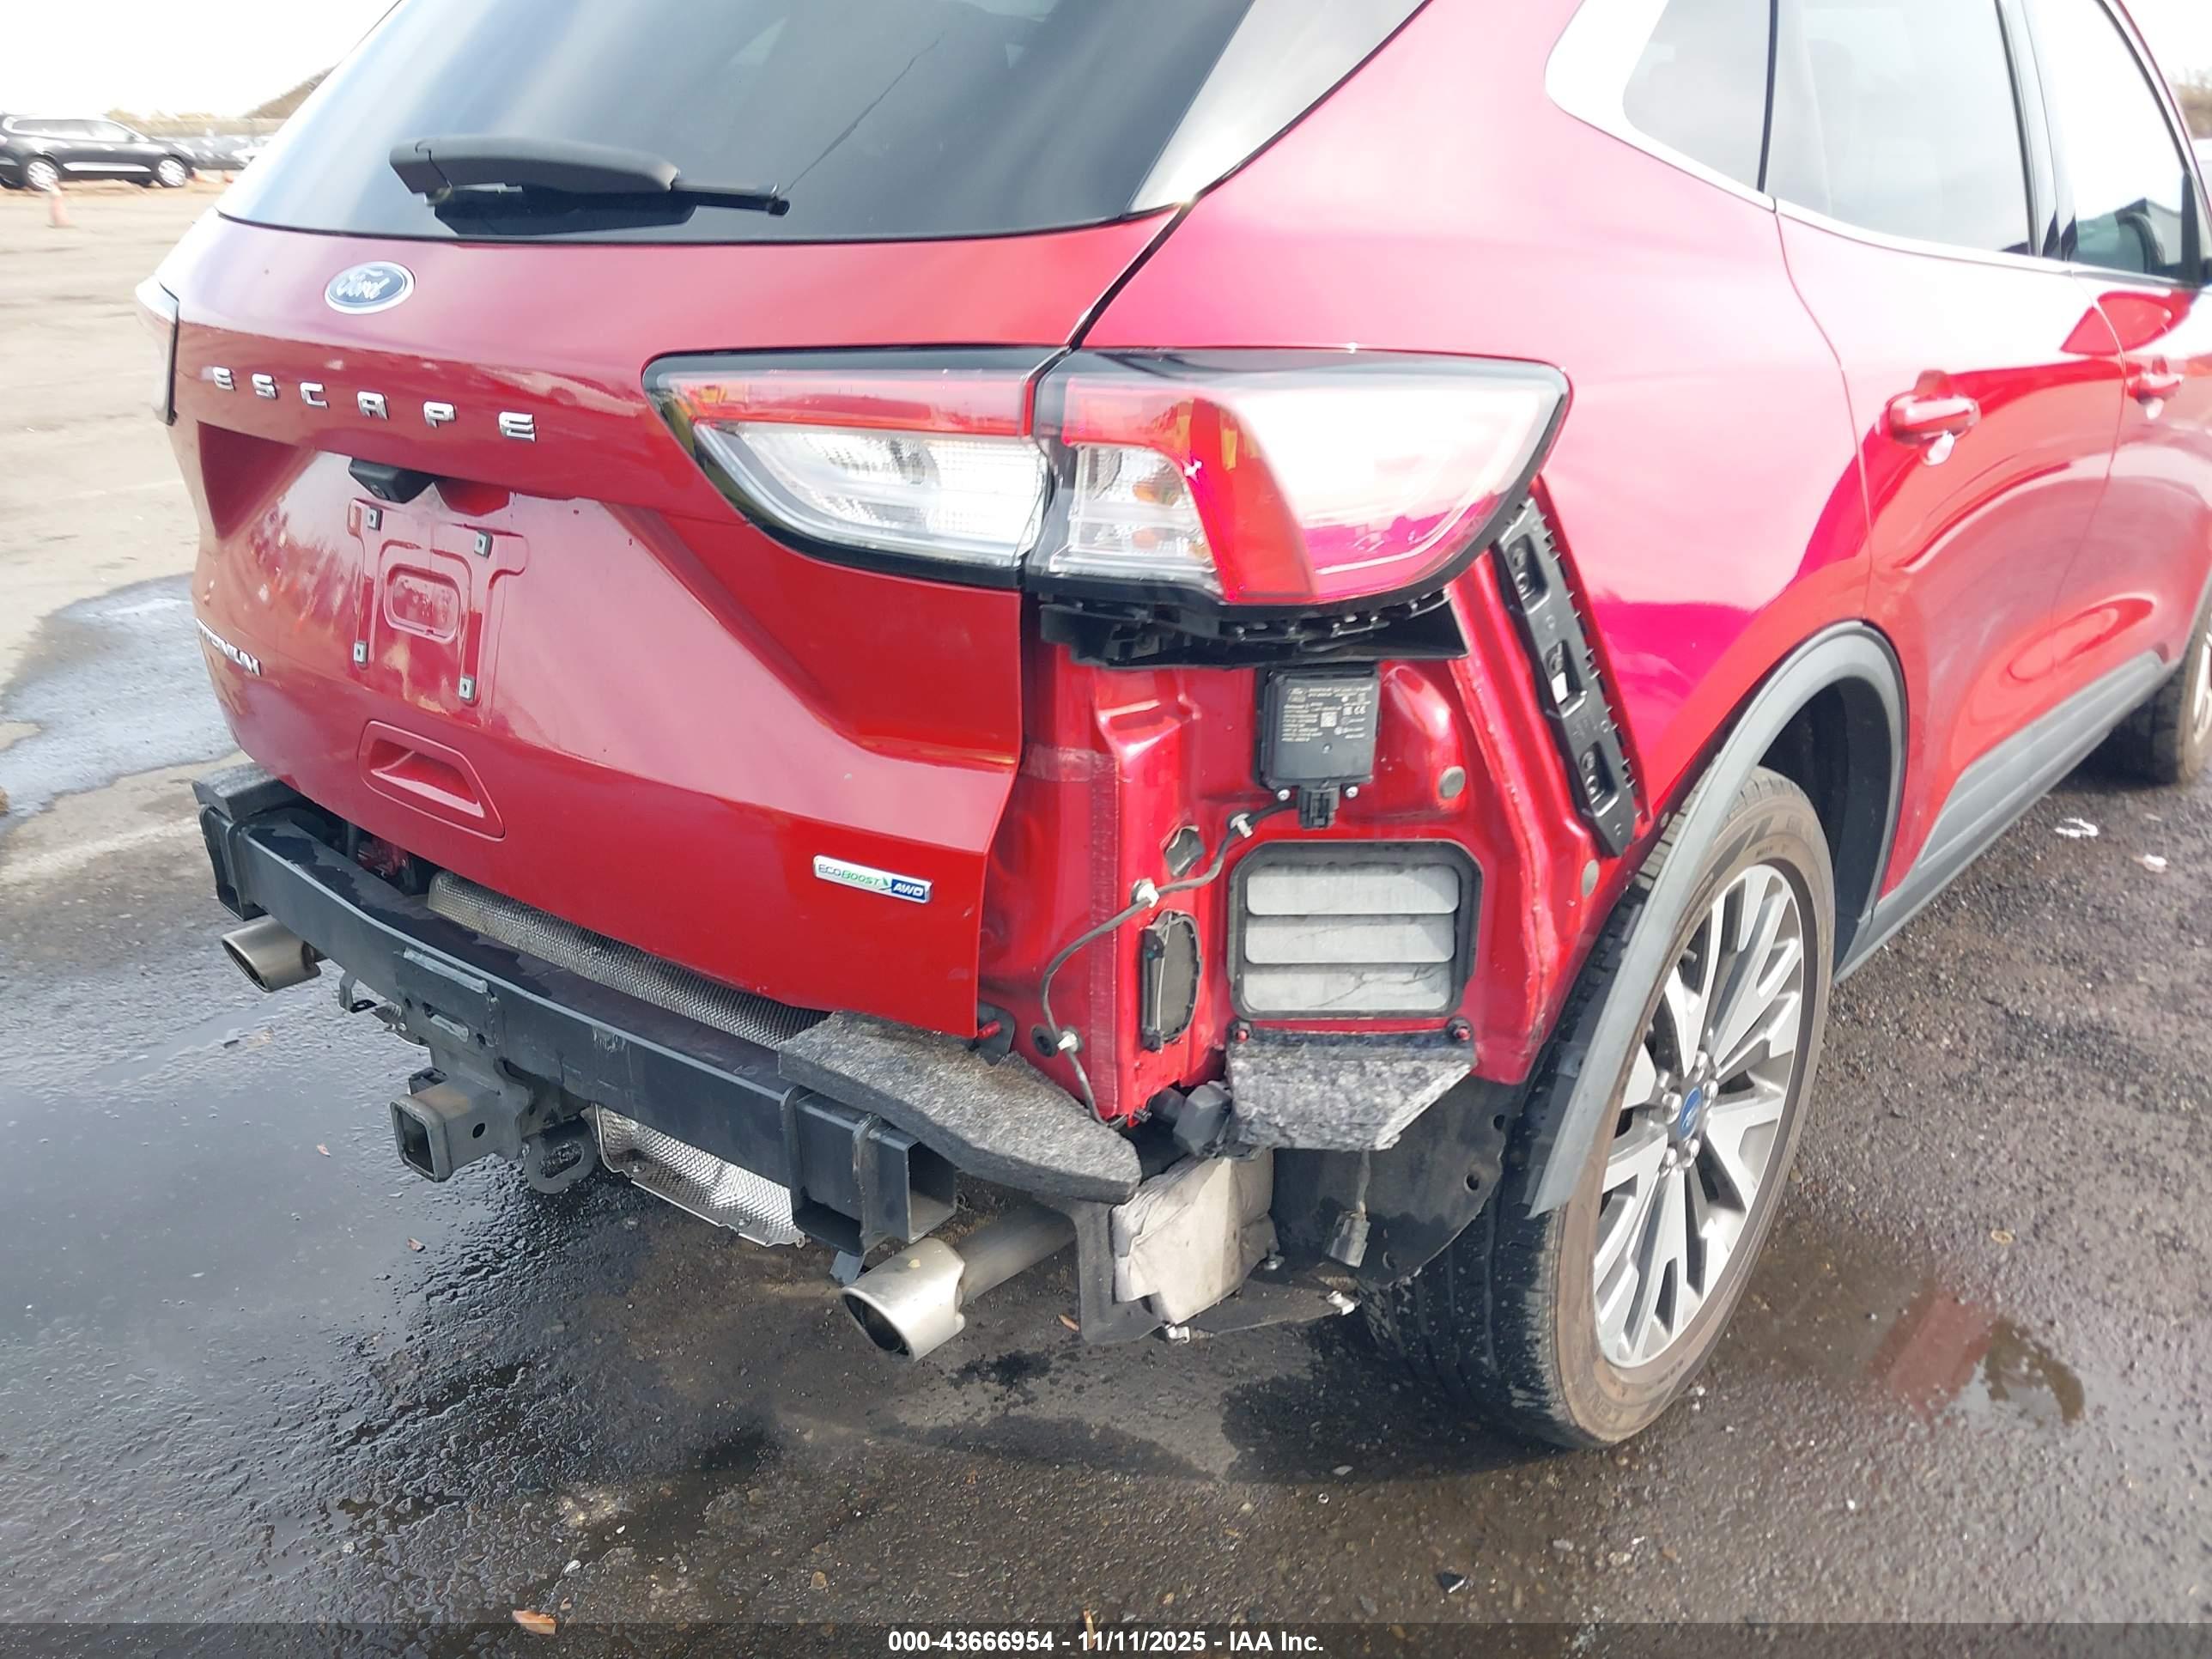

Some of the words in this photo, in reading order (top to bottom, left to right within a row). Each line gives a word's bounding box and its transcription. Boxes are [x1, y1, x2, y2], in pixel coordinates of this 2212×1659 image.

[336, 268, 391, 300] Ford
[212, 366, 537, 443] ESCAPE
[818, 863, 883, 887] ECOBOOST
[893, 882, 925, 898] AWD
